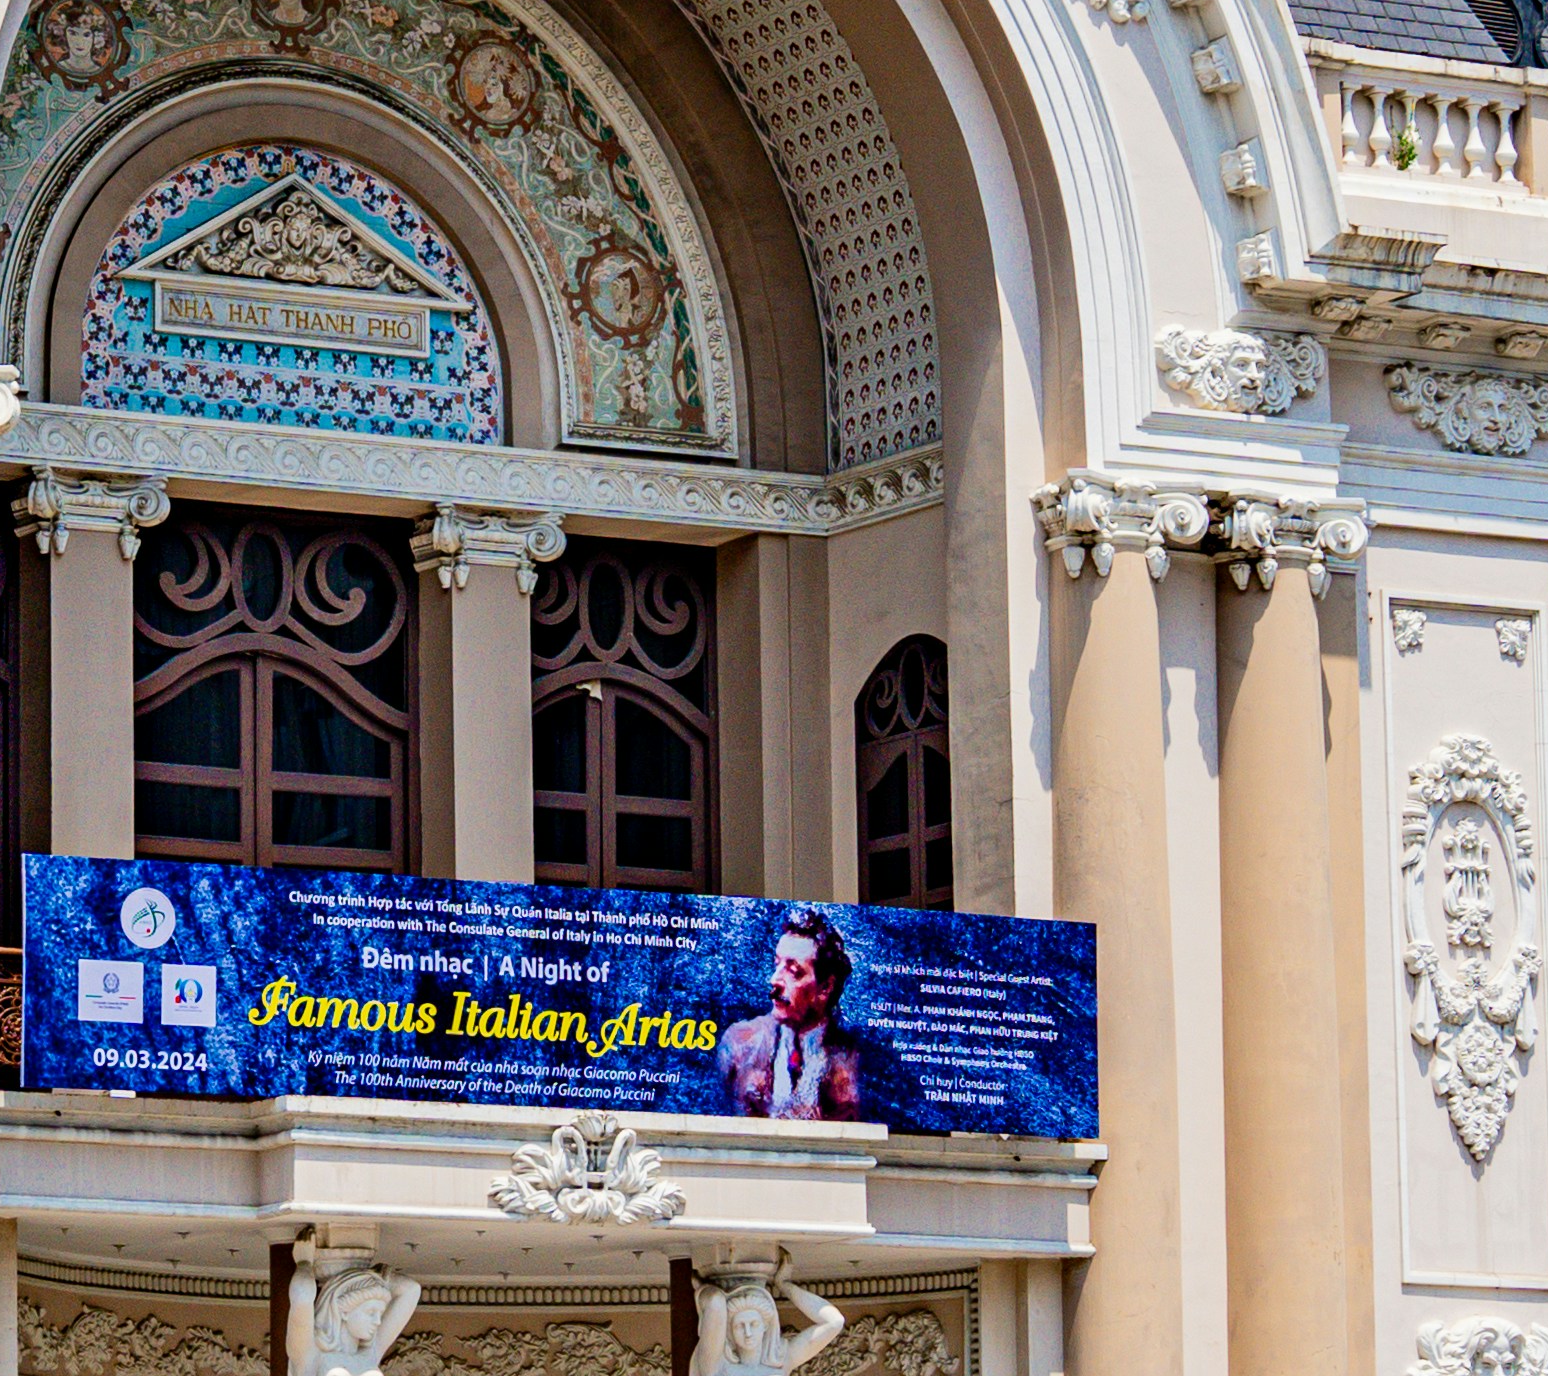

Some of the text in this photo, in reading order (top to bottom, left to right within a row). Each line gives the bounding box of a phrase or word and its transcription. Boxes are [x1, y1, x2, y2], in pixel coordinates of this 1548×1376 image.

[289, 891, 335, 907] Chương
[368, 896, 393, 911] Hợp
[395, 898, 412, 910] tác
[544, 908, 572, 921] Italia
[690, 916, 719, 930] Minh
[313, 913, 697, 951] In cooperation with The Consulate General of Italy in Ho Chi Minh City
[362, 947, 610, 985] Đêm nhạc A Night of
[248, 975, 718, 1058] Famous Italian Arias
[93, 1048, 208, 1072] 09.03.2024
[359, 1054, 379, 1067] 100
[584, 1066, 636, 1081] Giacomo
[639, 1069, 681, 1083] Puccini
[335, 1071, 655, 1101] The 100th Anniversary of the Death of Giacomo Puccini
[979, 1093, 1004, 1105] MINH
